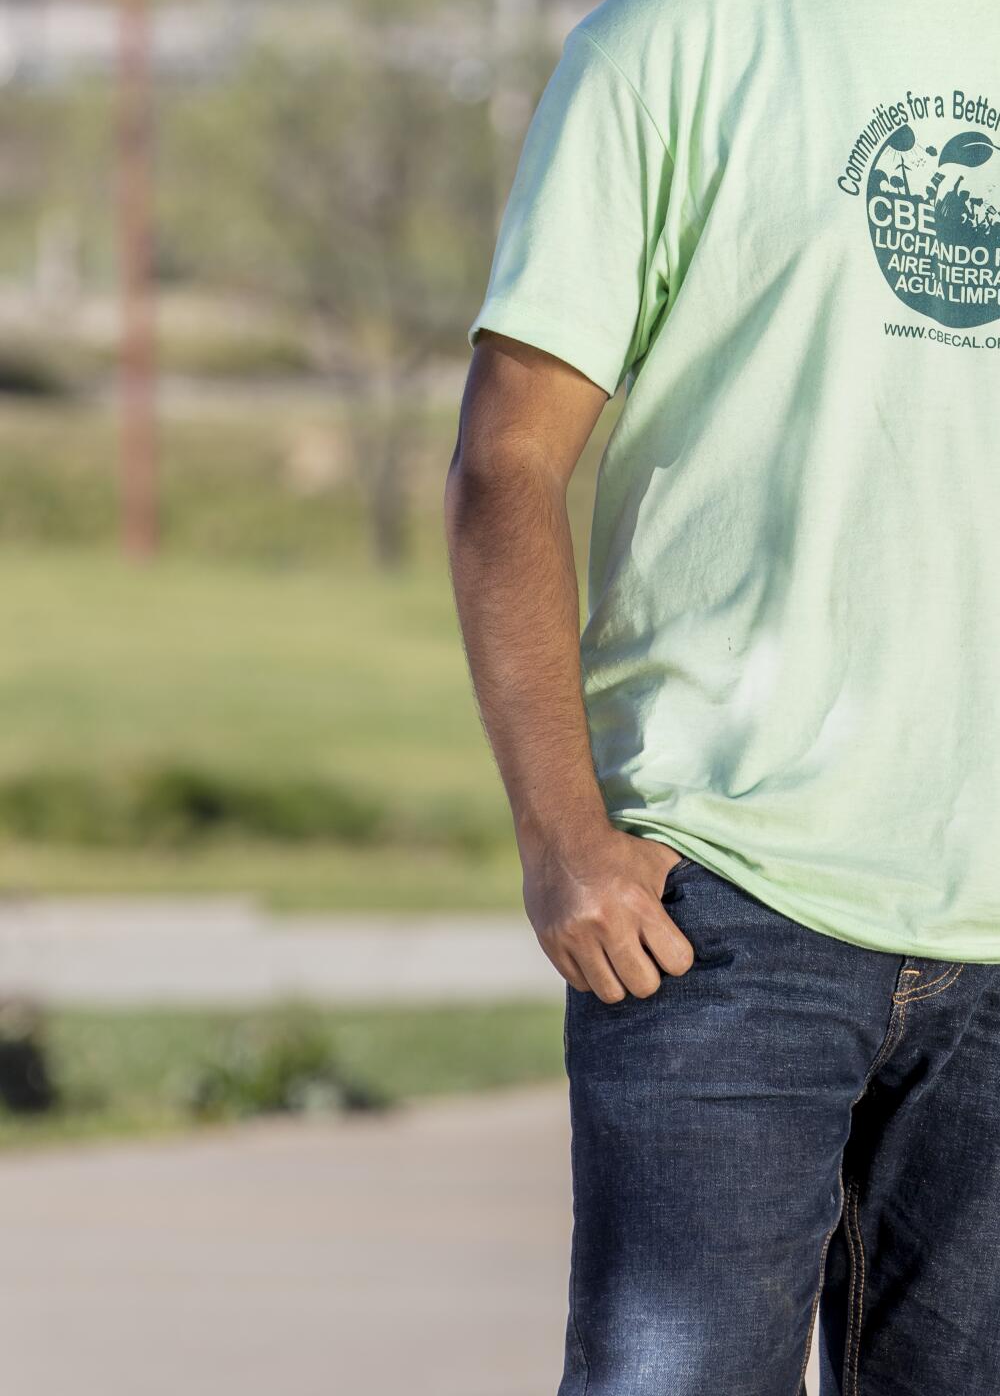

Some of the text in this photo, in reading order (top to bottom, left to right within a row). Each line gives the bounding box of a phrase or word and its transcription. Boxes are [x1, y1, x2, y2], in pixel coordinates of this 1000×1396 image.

[837, 102, 908, 196] Communities
[907, 91, 930, 120] for
[935, 96, 944, 117] a
[868, 196, 936, 235] CBE
[875, 229, 989, 266] LUCHANDO
[895, 275, 945, 299] AGUA
